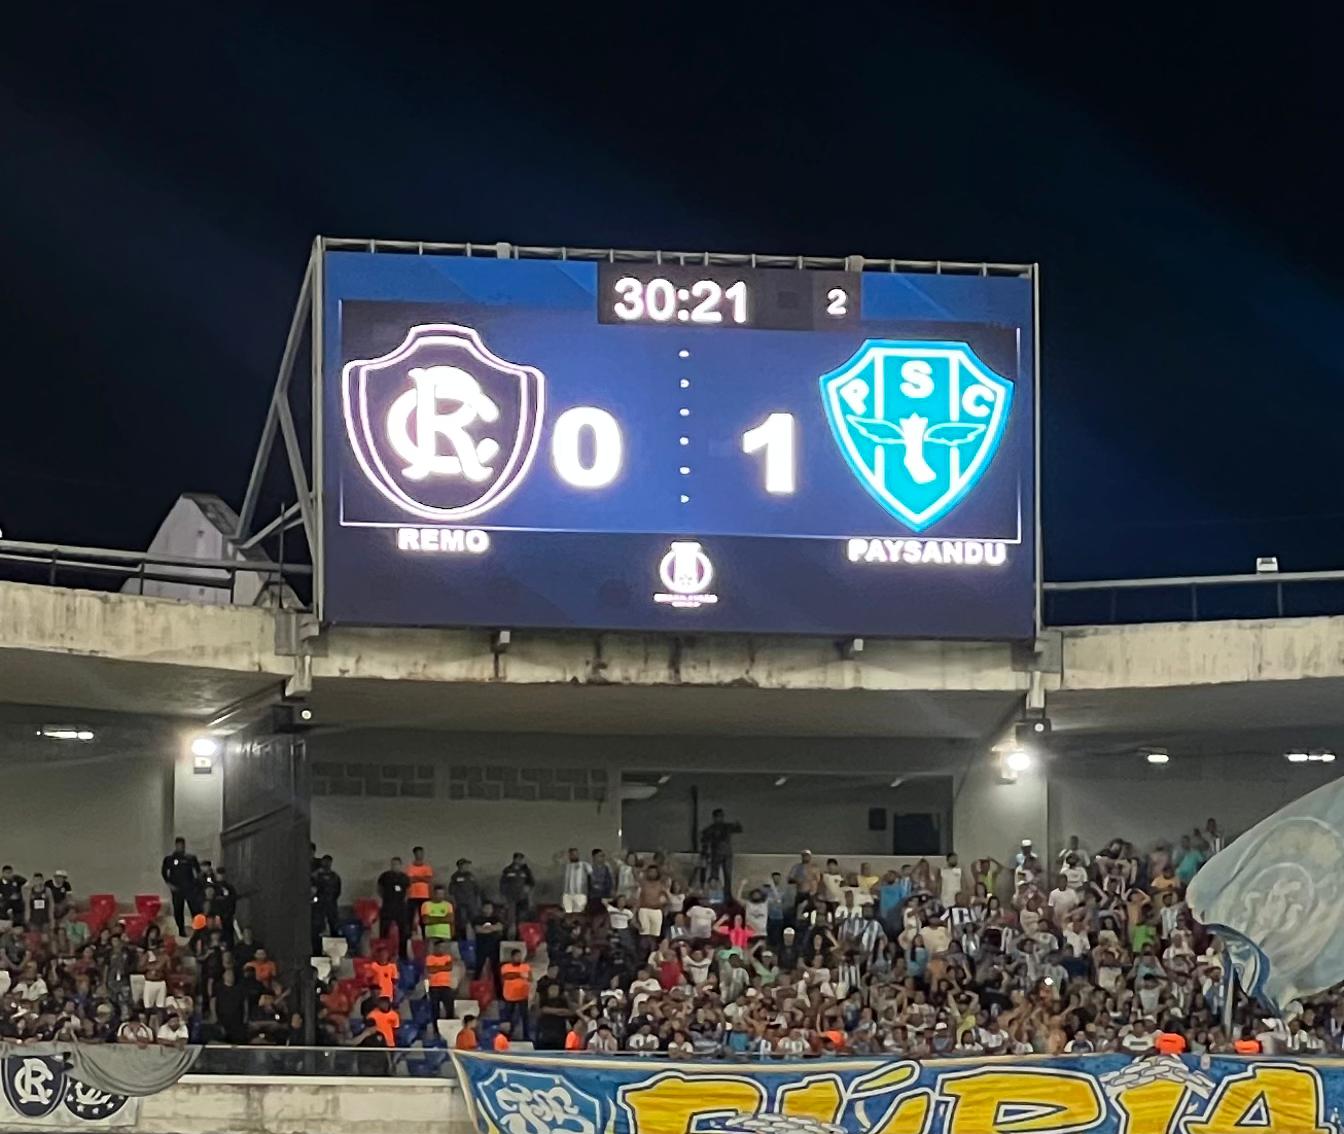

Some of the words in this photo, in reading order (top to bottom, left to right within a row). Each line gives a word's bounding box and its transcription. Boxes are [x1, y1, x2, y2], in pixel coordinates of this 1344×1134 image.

[614, 277, 748, 323] 30:21
[826, 288, 848, 316] 2
[551, 406, 622, 488] 0
[742, 412, 796, 493] 1
[397, 528, 490, 553] REMO
[847, 538, 1007, 565] PAYSANDU
